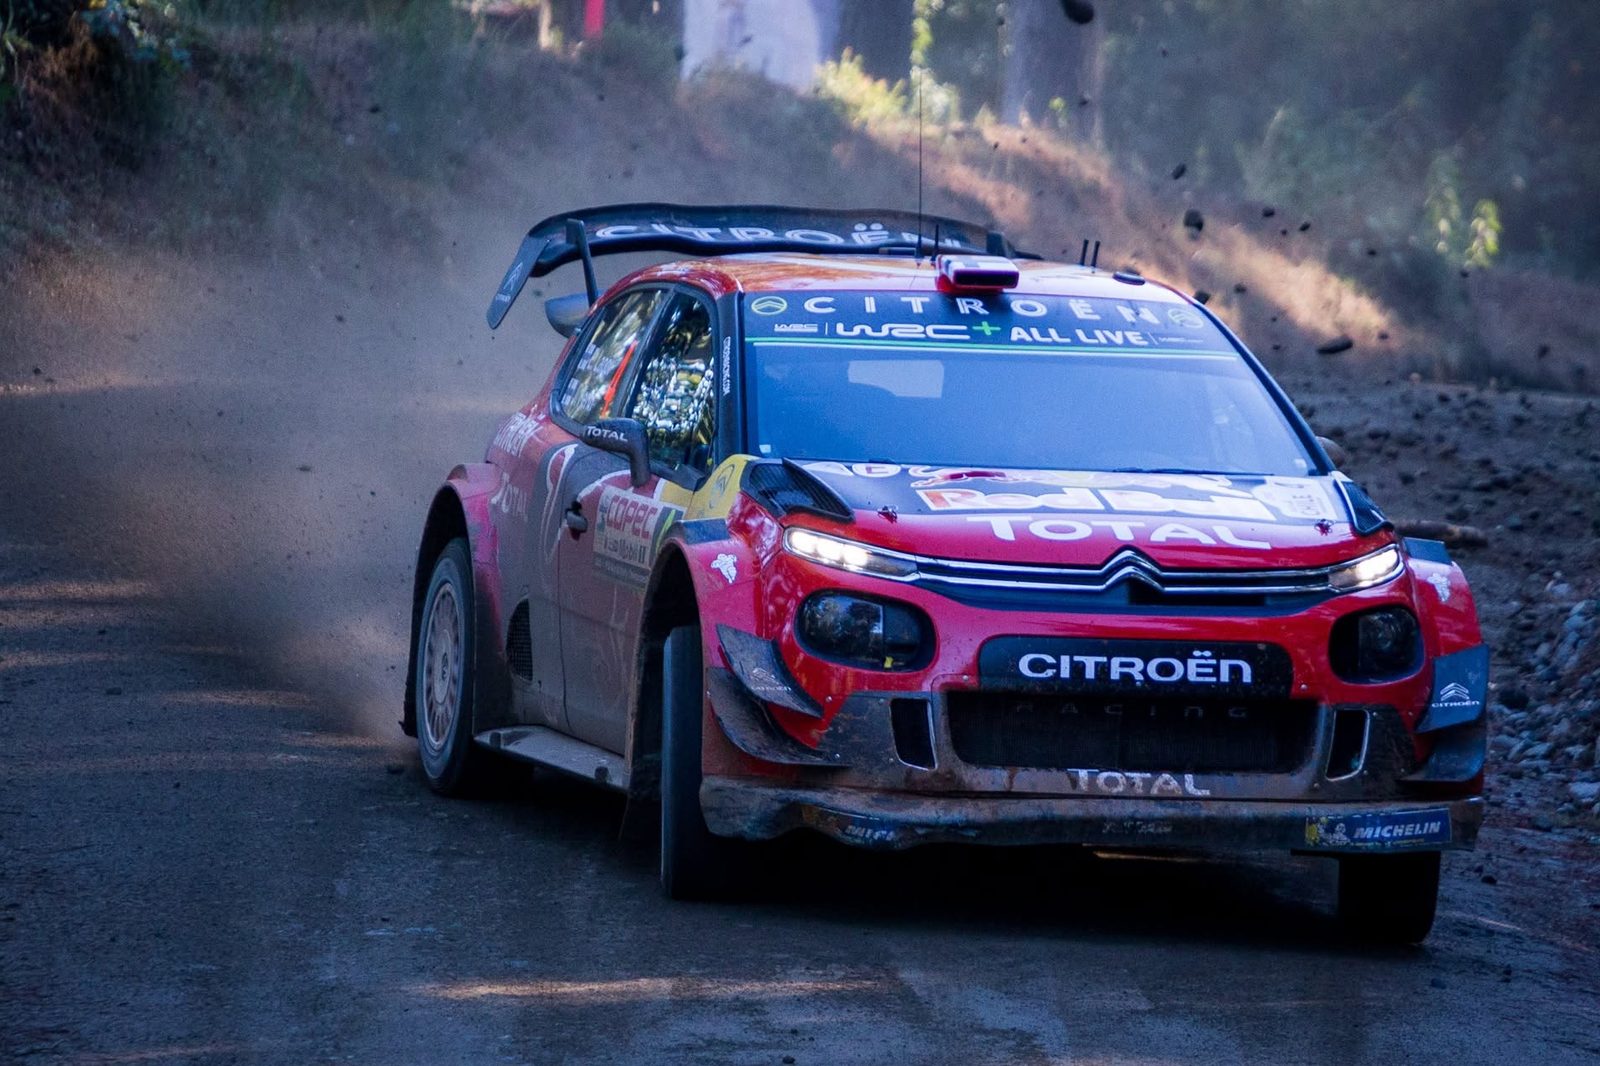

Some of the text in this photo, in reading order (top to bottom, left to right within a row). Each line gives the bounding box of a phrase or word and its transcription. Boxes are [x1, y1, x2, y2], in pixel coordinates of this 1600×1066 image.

[804, 296, 1161, 324] CITROËN
[1010, 326, 1071, 342] ALL
[1075, 328, 1149, 346] LIVE
[586, 425, 629, 442] TOTAL
[966, 515, 1272, 550] TOTAL
[1018, 650, 1252, 684] CITROËN
[1066, 768, 1211, 796] TOTAL
[1352, 820, 1442, 839] MICHELIN
